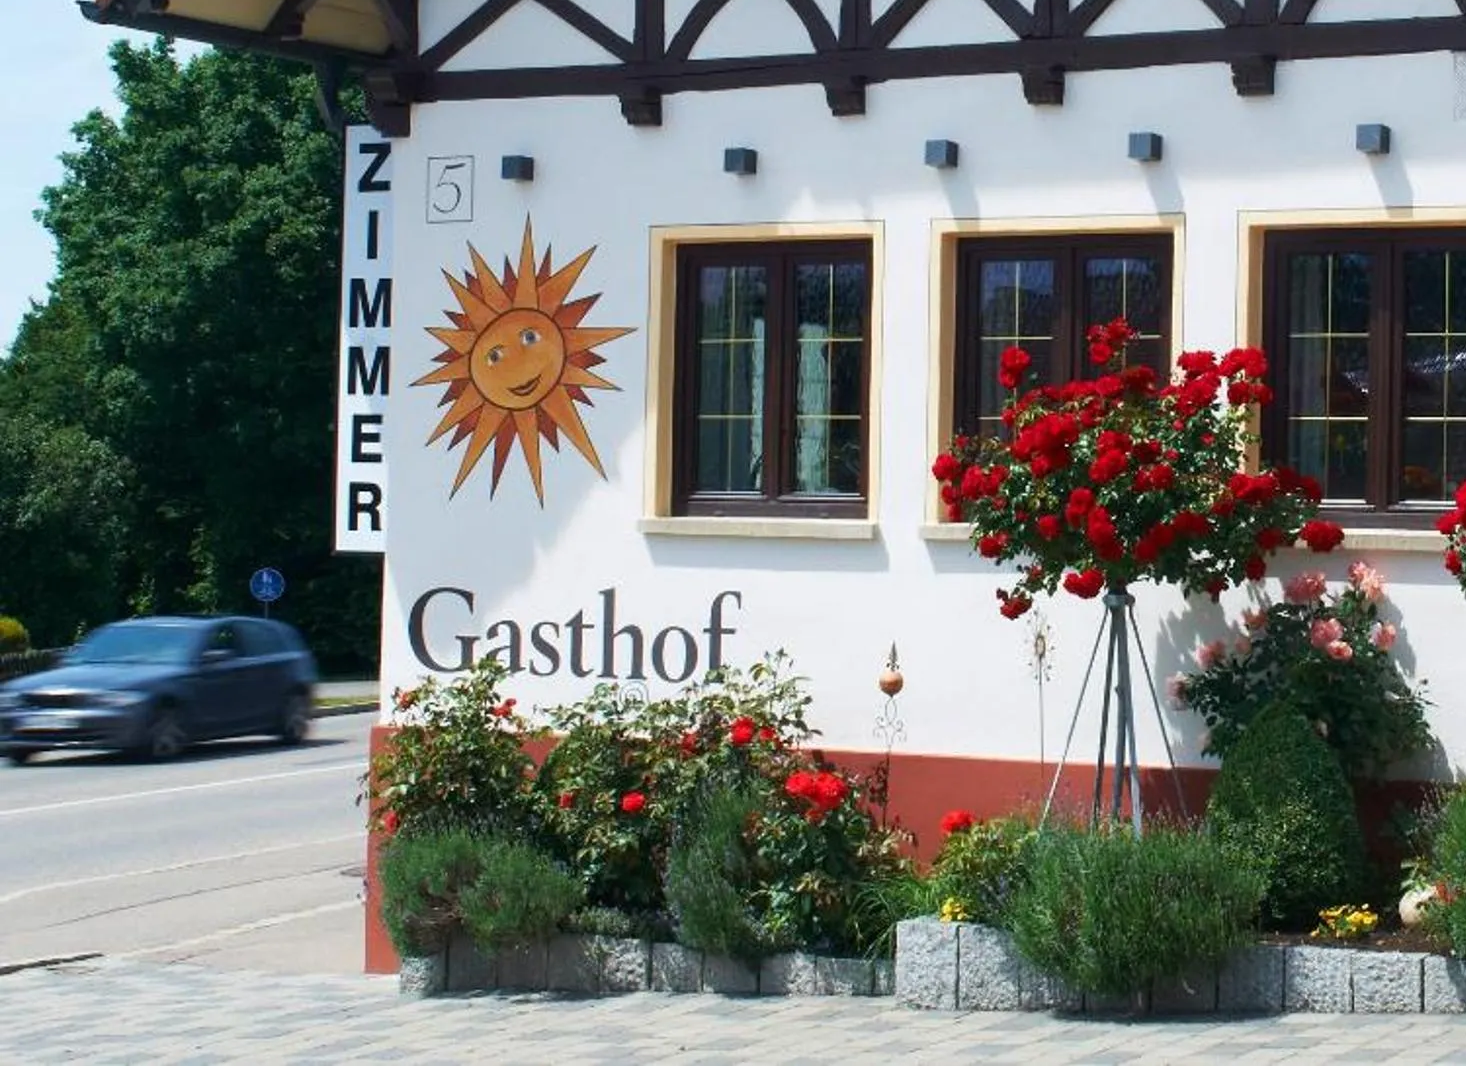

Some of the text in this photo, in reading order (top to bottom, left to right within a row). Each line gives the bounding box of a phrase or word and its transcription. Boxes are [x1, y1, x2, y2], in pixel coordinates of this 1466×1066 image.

[432, 163, 467, 215] 5
[347, 142, 392, 532] ZIMMER
[408, 587, 742, 683] Gasthof
